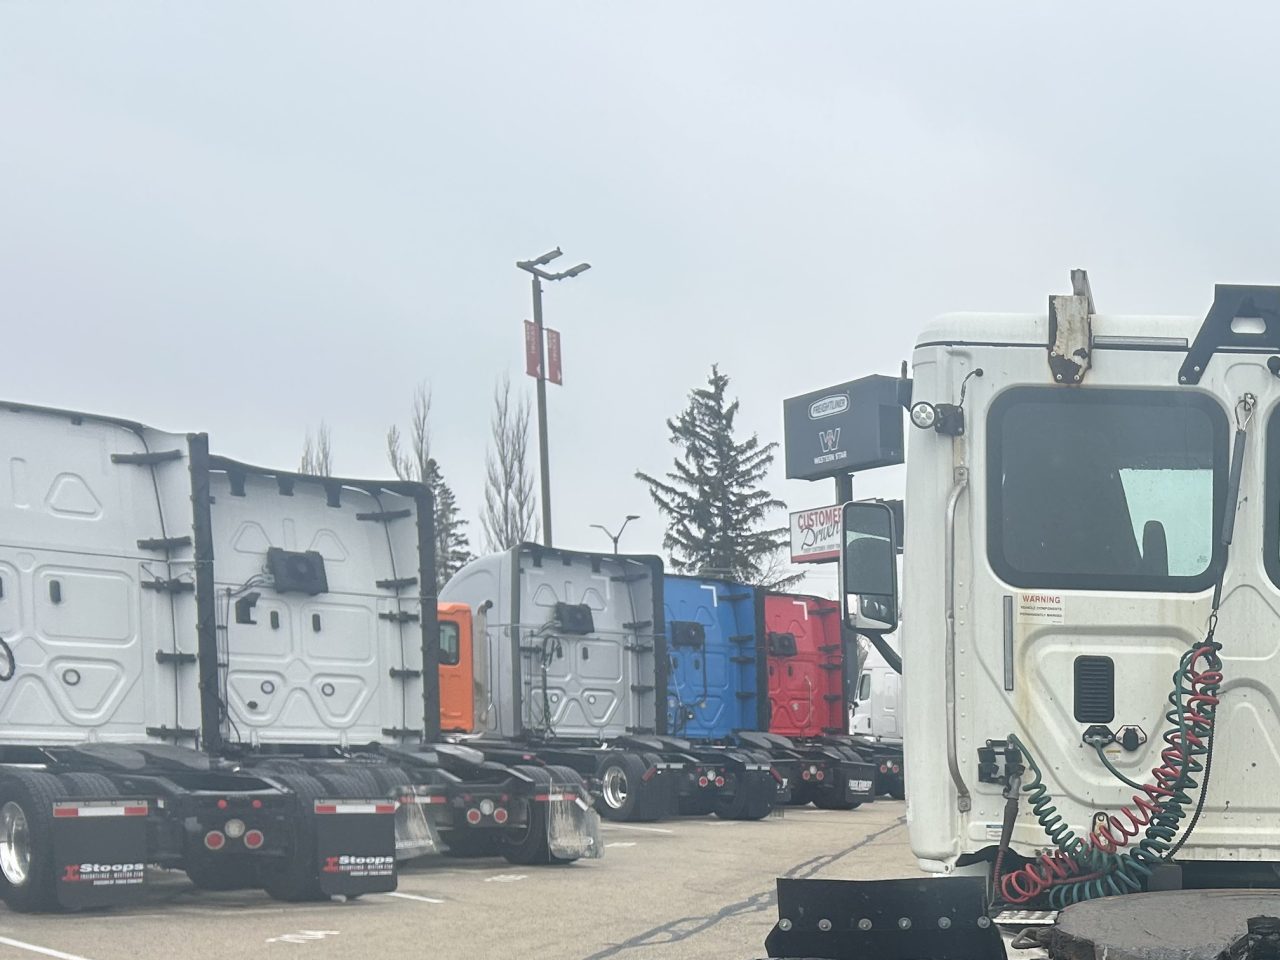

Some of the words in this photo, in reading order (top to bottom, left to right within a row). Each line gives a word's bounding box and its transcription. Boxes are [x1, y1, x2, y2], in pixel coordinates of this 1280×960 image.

[814, 454, 835, 464] WESTERN
[835, 450, 847, 460] STAR
[1022, 595, 1061, 604] WARNING
[339, 856, 393, 865] Stoops
[80, 863, 144, 873] Stoops
